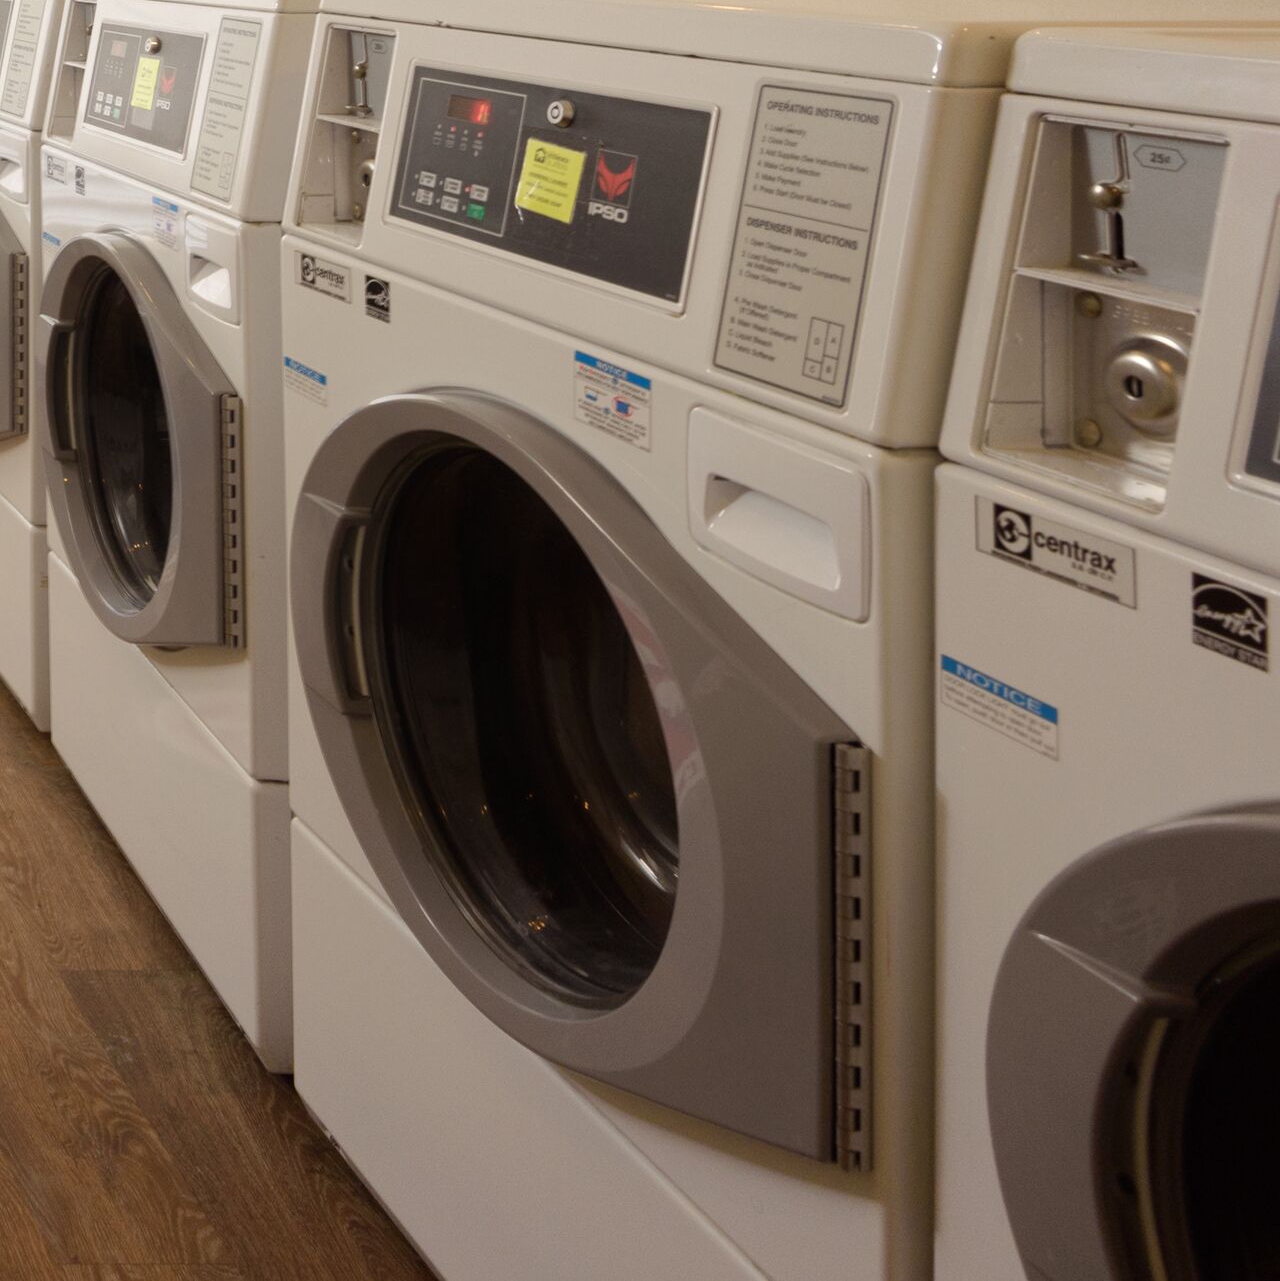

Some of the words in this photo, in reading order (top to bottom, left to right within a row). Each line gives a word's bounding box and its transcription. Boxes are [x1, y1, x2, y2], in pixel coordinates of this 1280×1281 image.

[767, 100, 813, 116] OPERATING
[815, 107, 880, 125] INSTRUCTIONS
[1149, 151, 1172, 165] 25¢
[588, 201, 629, 224] IPSO
[747, 217, 792, 234] DISPENSER
[794, 227, 858, 251] INSTRUCTIONS
[1034, 531, 1117, 574] centrax
[1192, 629, 1237, 660] ENERGY
[1237, 646, 1268, 672] STAR
[956, 663, 1041, 715] NOTICE
